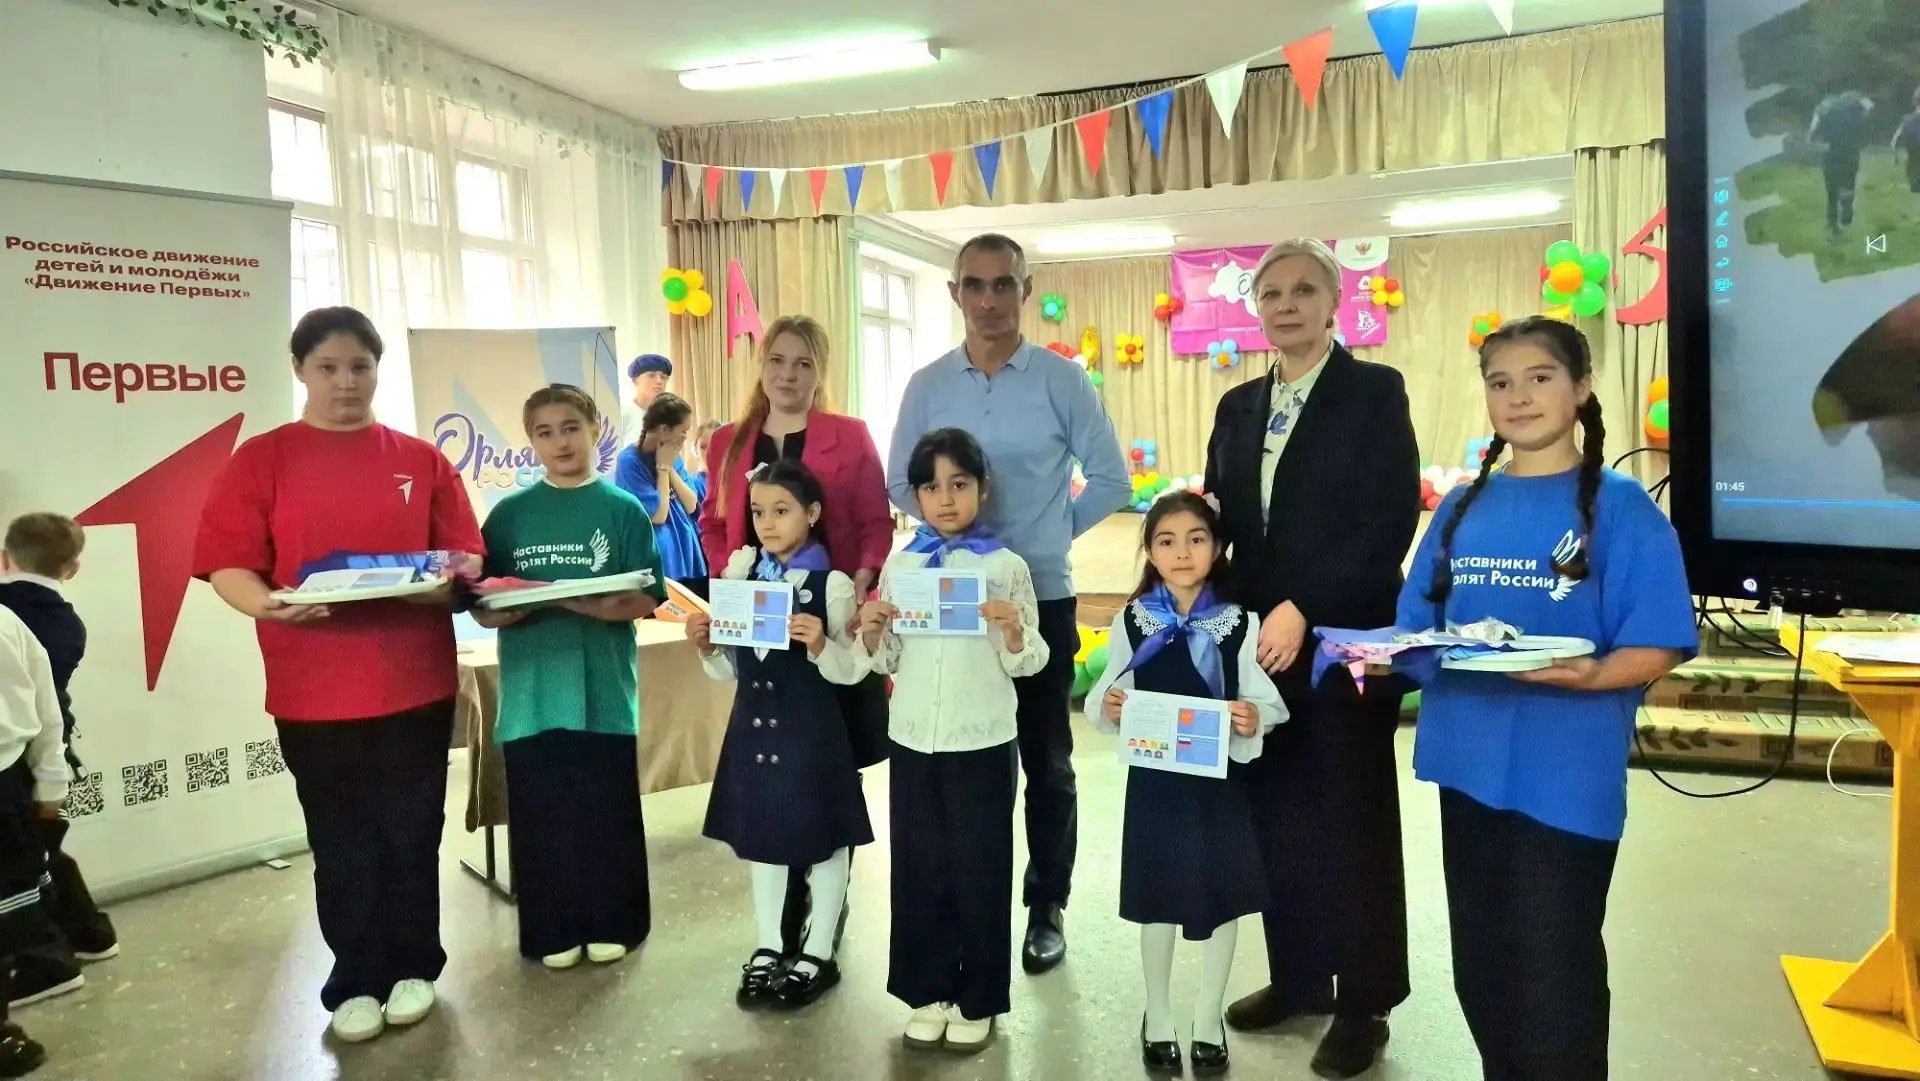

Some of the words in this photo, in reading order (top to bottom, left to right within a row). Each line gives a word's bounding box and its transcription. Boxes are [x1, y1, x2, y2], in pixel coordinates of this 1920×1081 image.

[5, 235, 149, 259] Российское
[152, 250, 260, 268] движение
[35, 259, 104, 273] детей
[109, 264, 123, 275] и
[128, 266, 241, 282] молодёжи
[24, 274, 156, 294] «Движение
[160, 282, 250, 299] Первых»
[44, 352, 246, 404] Первые
[433, 413, 541, 481] Орля
[1715, 481, 1745, 492] 01:45
[513, 543, 584, 560] Наставники
[550, 553, 592, 566] России
[1490, 571, 1555, 589] России
